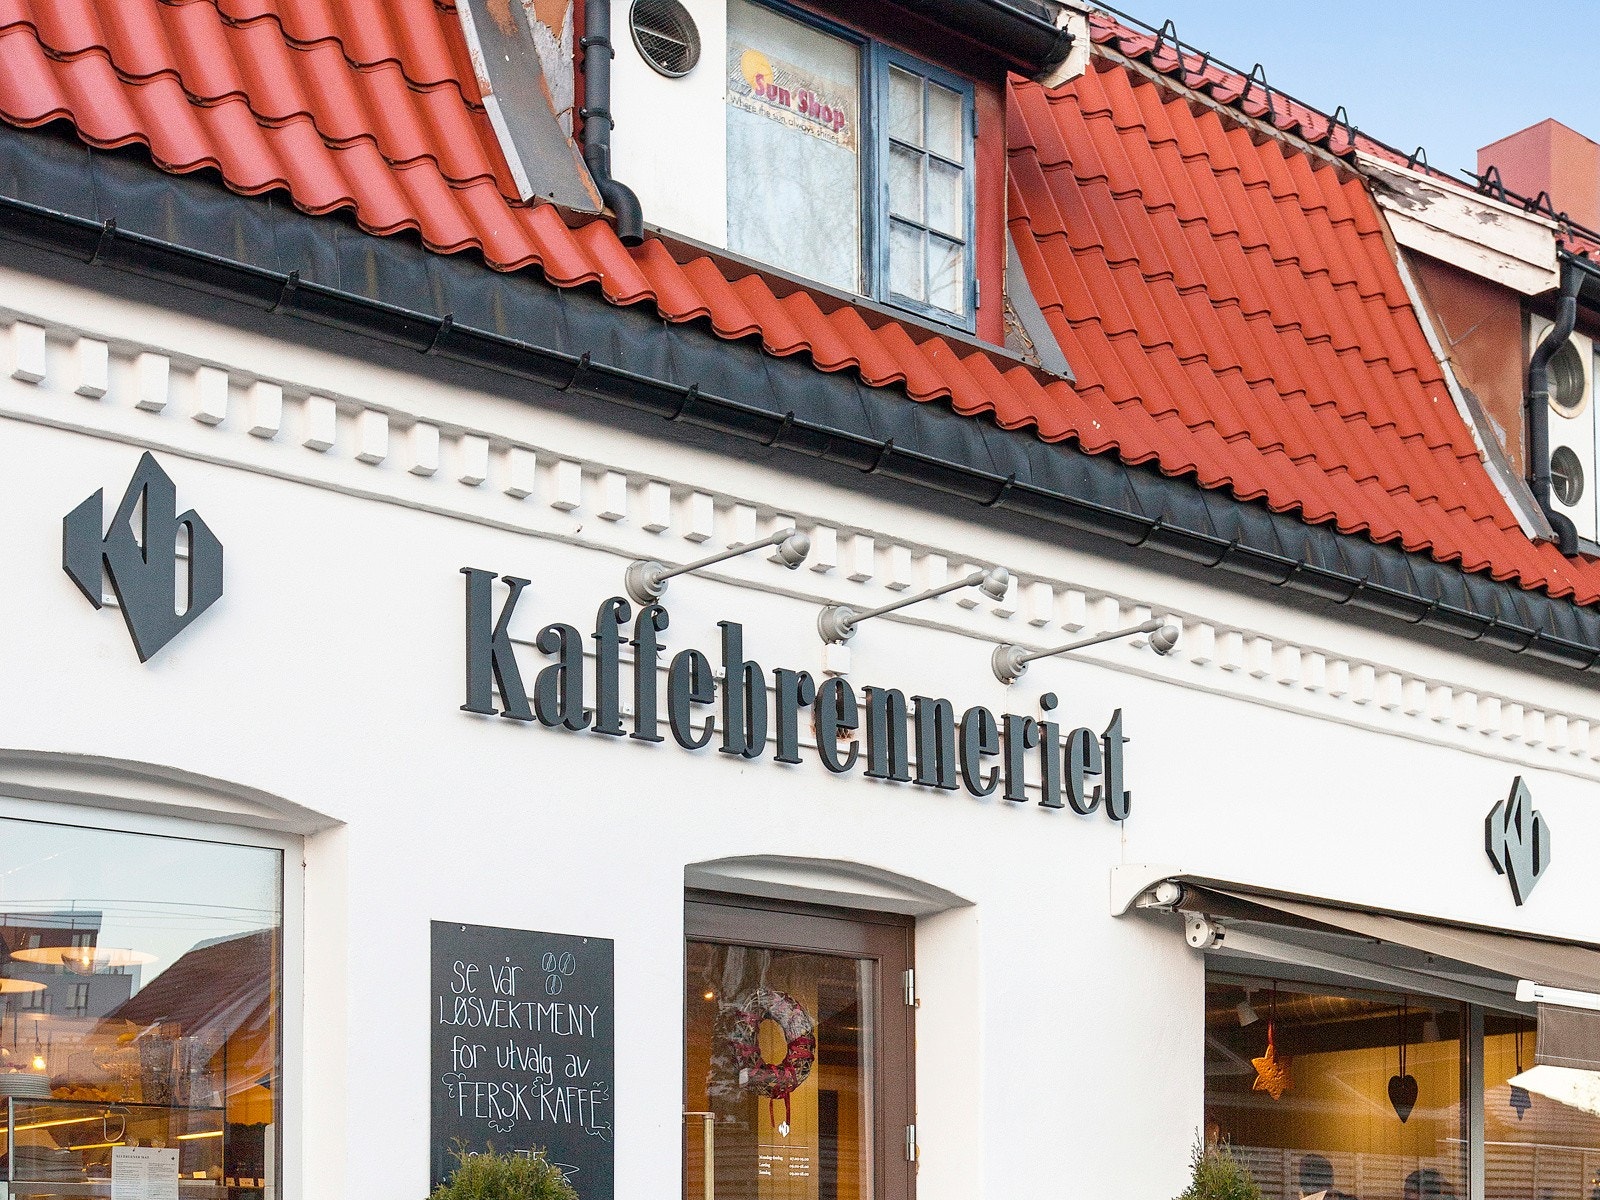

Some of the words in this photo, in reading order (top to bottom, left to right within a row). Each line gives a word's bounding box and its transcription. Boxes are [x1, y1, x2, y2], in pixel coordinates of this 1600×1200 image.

[754, 73, 791, 108] Sun
[798, 87, 845, 134] Shop
[459, 566, 1132, 822] Kaffebrenneriet
[488, 956, 524, 997] vår
[439, 995, 599, 1038] LØSVEKTMENY
[450, 1035, 487, 1072] for
[496, 1039, 554, 1086] utvalg
[564, 1054, 591, 1078] av
[458, 1081, 532, 1121] FERSK
[540, 1083, 606, 1130] KAFFE
